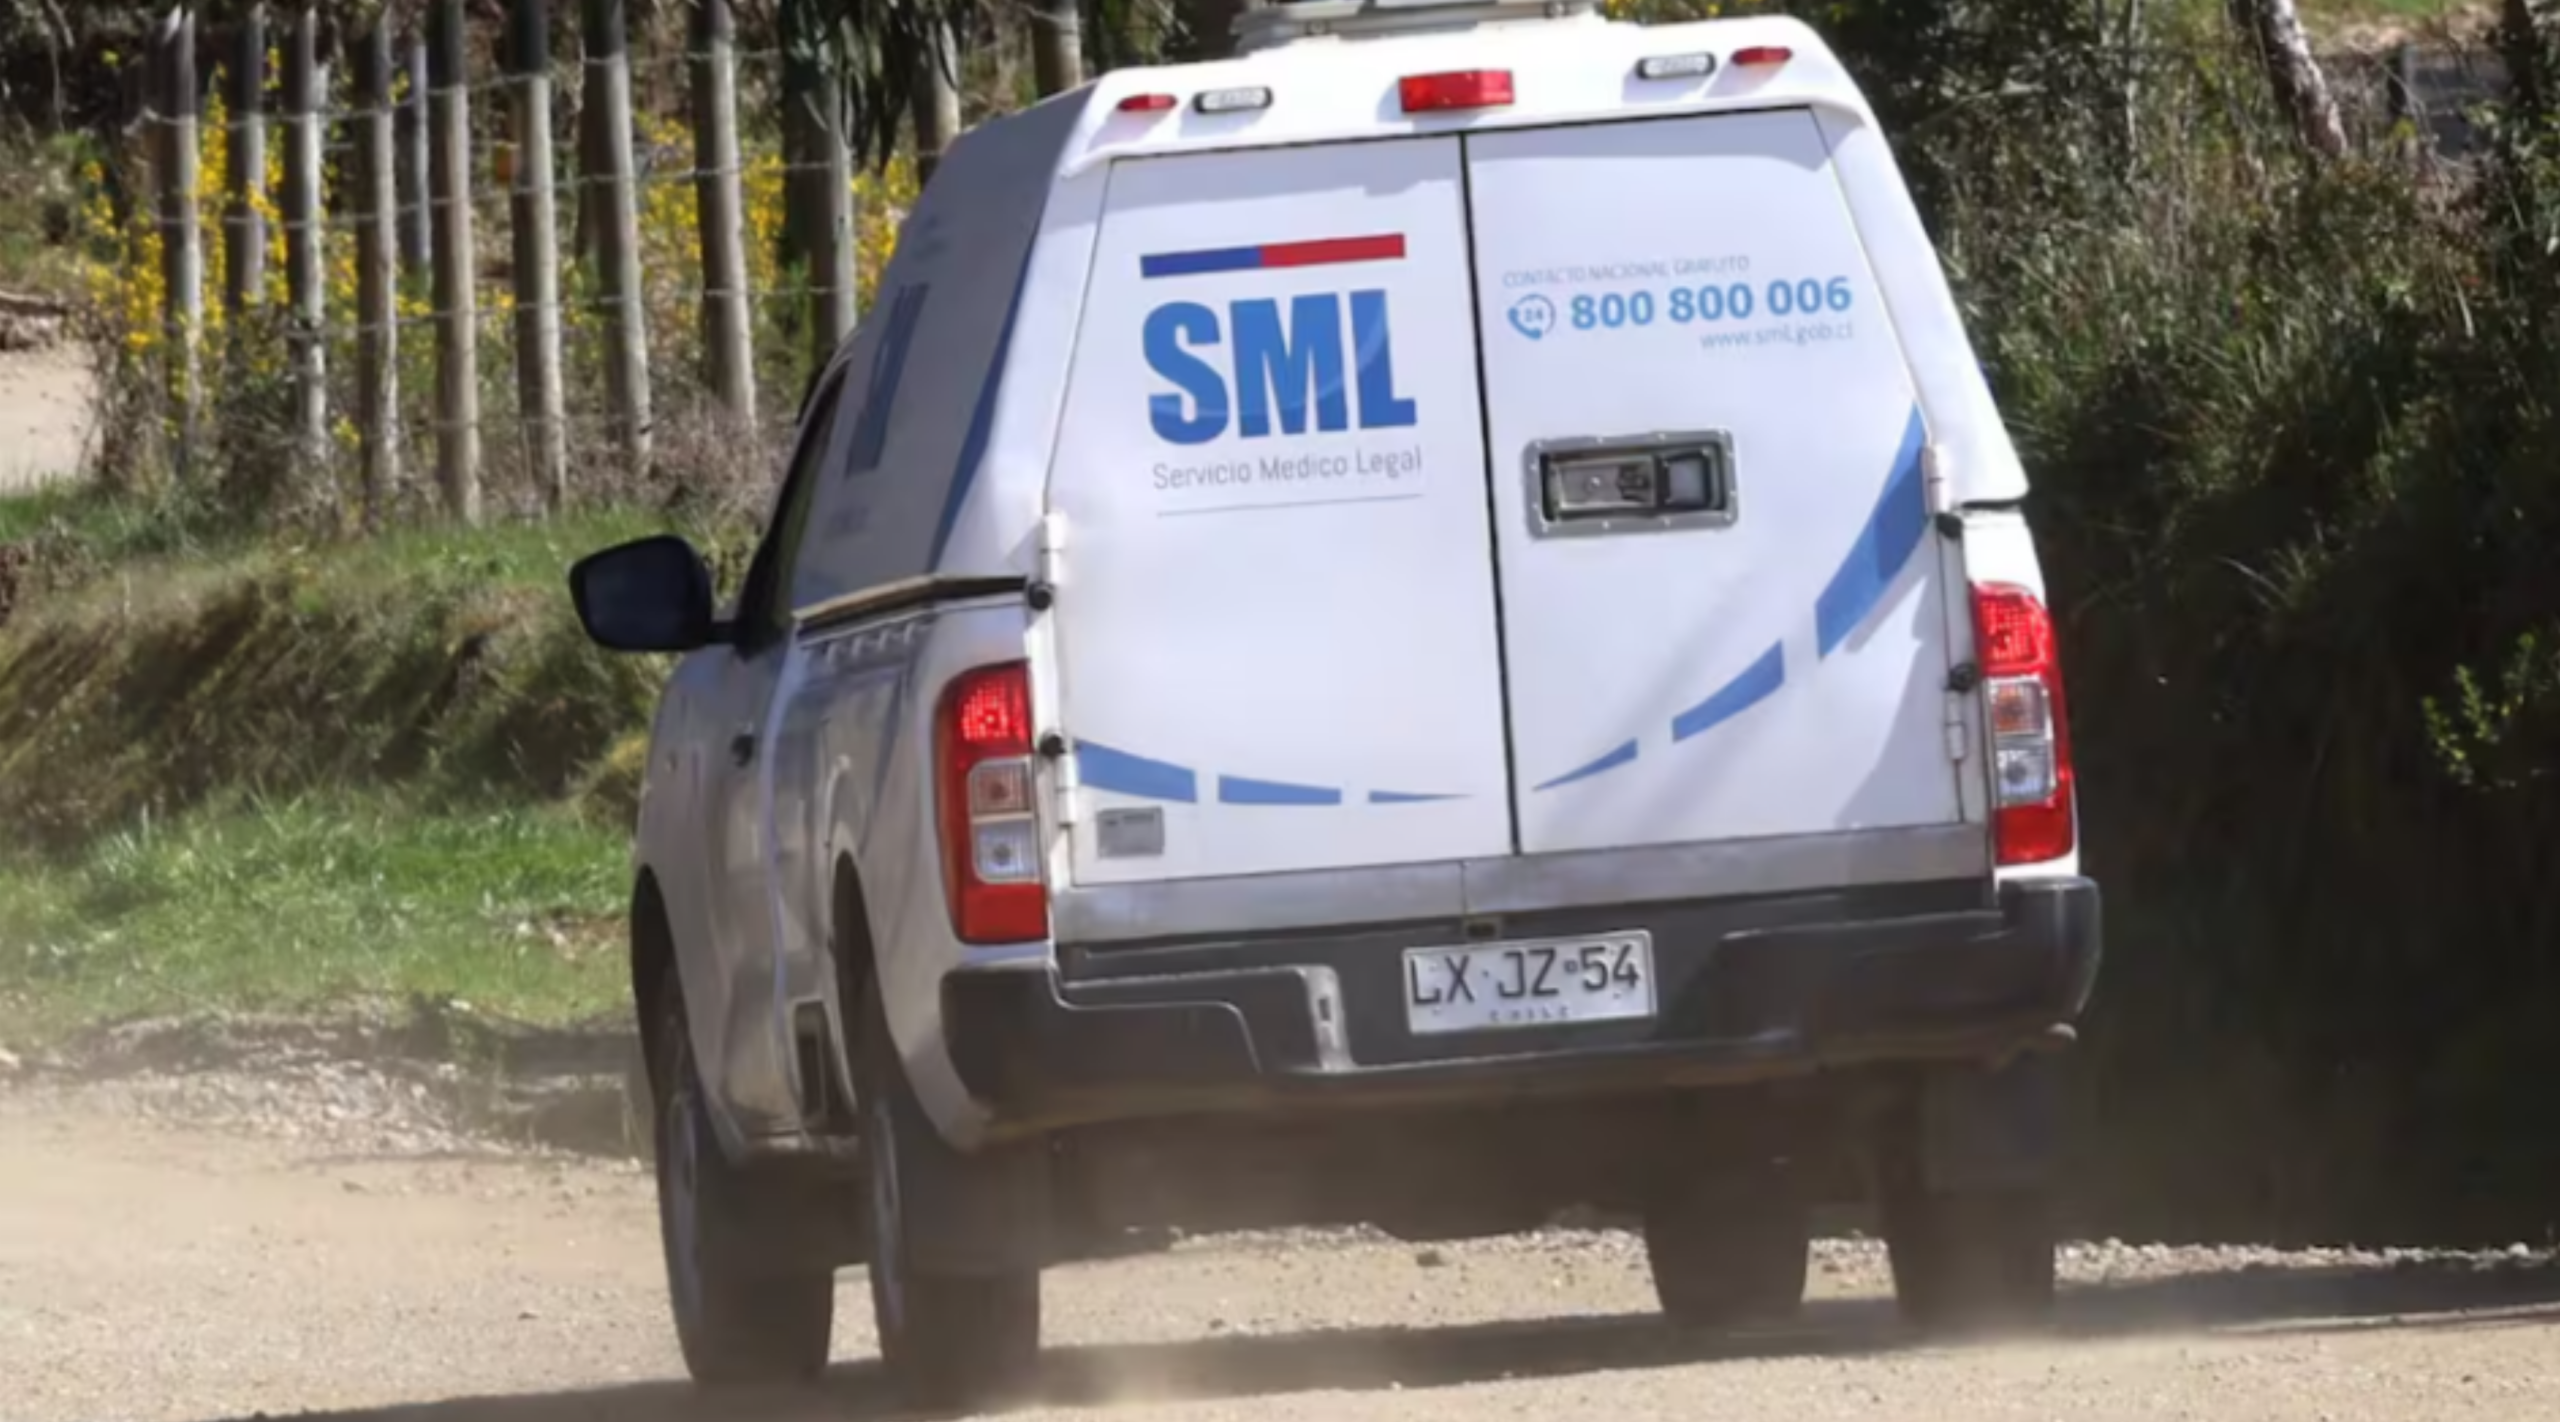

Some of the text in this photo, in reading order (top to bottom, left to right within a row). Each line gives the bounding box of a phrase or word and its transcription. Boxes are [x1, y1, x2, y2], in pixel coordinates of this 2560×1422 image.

[1588, 259, 1667, 282] NACIONAL
[1570, 276, 1852, 330] 800 800 006
[1141, 288, 1418, 446] SML
[1152, 460, 1252, 490] Servicio
[1355, 445, 1422, 479] Legal
